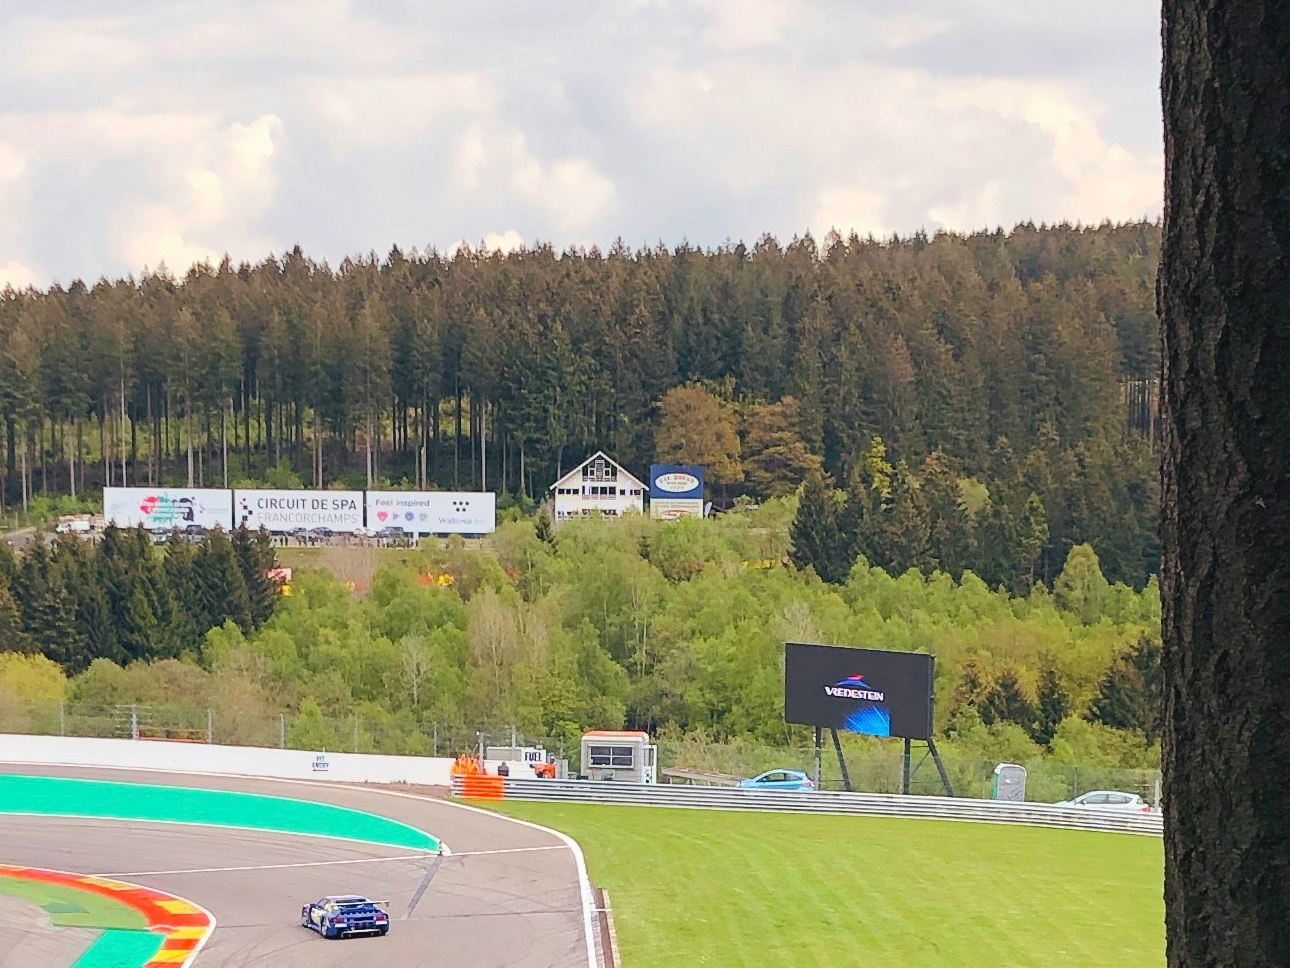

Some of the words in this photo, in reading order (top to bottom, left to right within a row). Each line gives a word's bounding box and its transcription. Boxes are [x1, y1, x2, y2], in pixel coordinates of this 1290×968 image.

[257, 498, 307, 510] CIRCUIT
[311, 499, 328, 510] DE
[332, 499, 357, 510] SPA
[257, 512, 358, 524] FRANCORCHAMPS
[824, 686, 884, 701] VREDESTEIN
[524, 751, 542, 762] FUEL
